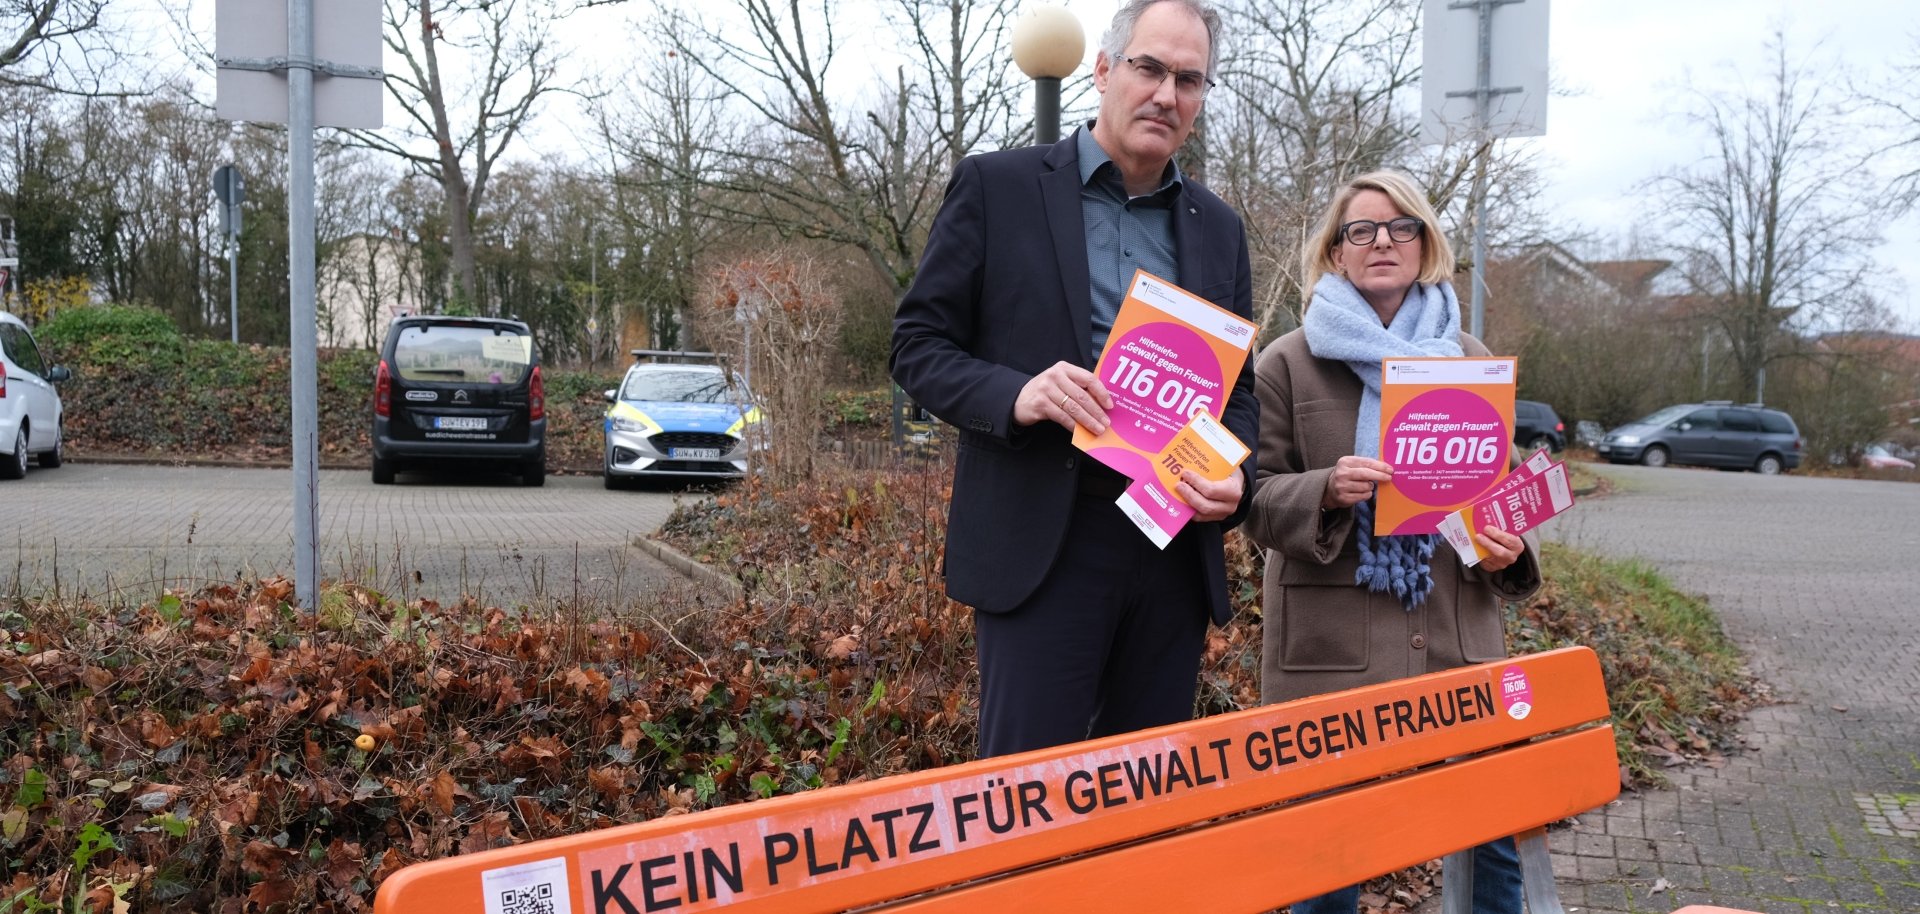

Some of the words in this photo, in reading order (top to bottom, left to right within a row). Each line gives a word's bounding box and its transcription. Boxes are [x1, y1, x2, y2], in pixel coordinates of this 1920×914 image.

[1139, 336, 1178, 360] Hilfetelefon
[1120, 342, 1158, 363] „Gewalt
[1156, 357, 1184, 376] gegen
[1184, 368, 1219, 390] Frauen“
[1109, 356, 1159, 398] 116
[1156, 379, 1213, 420] 016
[1394, 422, 1431, 432] „Gewalt
[1432, 424, 1460, 432] gegen
[1462, 422, 1498, 431] Frauen“
[1408, 413, 1450, 421] Hilfetelefon
[693, 449, 703, 458] KV
[705, 450, 719, 458] 320
[1183, 437, 1210, 463] Hilfetelefon
[1395, 437, 1438, 465] 116
[1443, 436, 1498, 465] 016
[1162, 454, 1184, 476] 116
[1194, 460, 1210, 474] gegen
[1506, 492, 1522, 512] 116
[1512, 511, 1528, 532] 016
[1504, 682, 1515, 694] 116
[1515, 679, 1526, 691] 016
[591, 842, 744, 914] KEIN
[763, 802, 941, 885] PLATZ
[954, 778, 1053, 842] FÜR
[1064, 738, 1231, 816] GEWALT
[1245, 709, 1367, 772] GEGEN
[1375, 683, 1495, 743] FRAUEN
